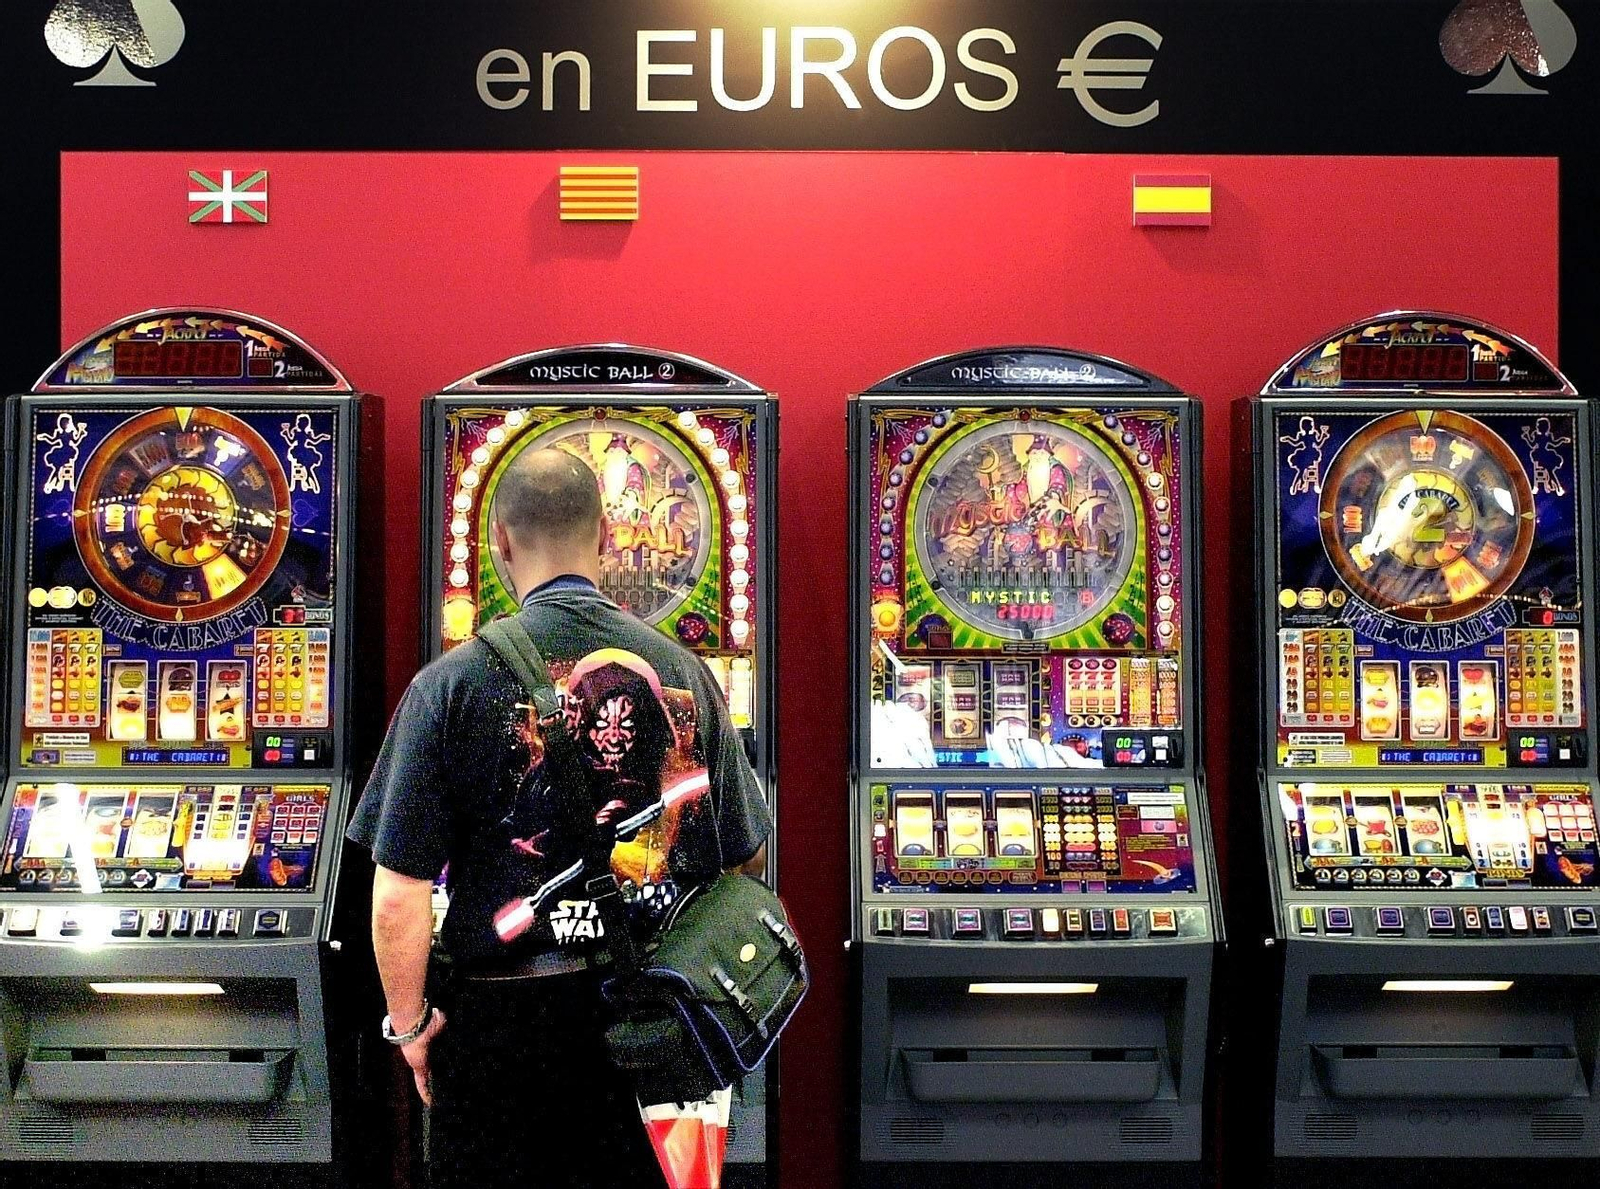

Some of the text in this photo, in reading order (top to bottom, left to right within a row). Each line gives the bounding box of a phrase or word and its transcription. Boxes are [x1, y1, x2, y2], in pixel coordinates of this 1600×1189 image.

[475, 20, 1164, 128] en EUROS €
[274, 360, 286, 379] 2
[607, 365, 654, 380] BALL
[1499, 365, 1511, 382] 2
[1411, 498, 1446, 543] 2
[613, 522, 688, 552] BALL
[971, 590, 1051, 604] MYSTIC
[997, 604, 1056, 620] 25000
[93, 601, 266, 650] THE CABARET
[1346, 602, 1514, 651] THE CABARET
[1115, 737, 1132, 749] 00
[1520, 736, 1535, 748] 00
[142, 752, 217, 762] THE CABARET
[1393, 752, 1466, 762] THE CABARET
[286, 794, 314, 802] GIRLS
[1046, 852, 1062, 860] 100
[1478, 859, 1486, 867] 2
